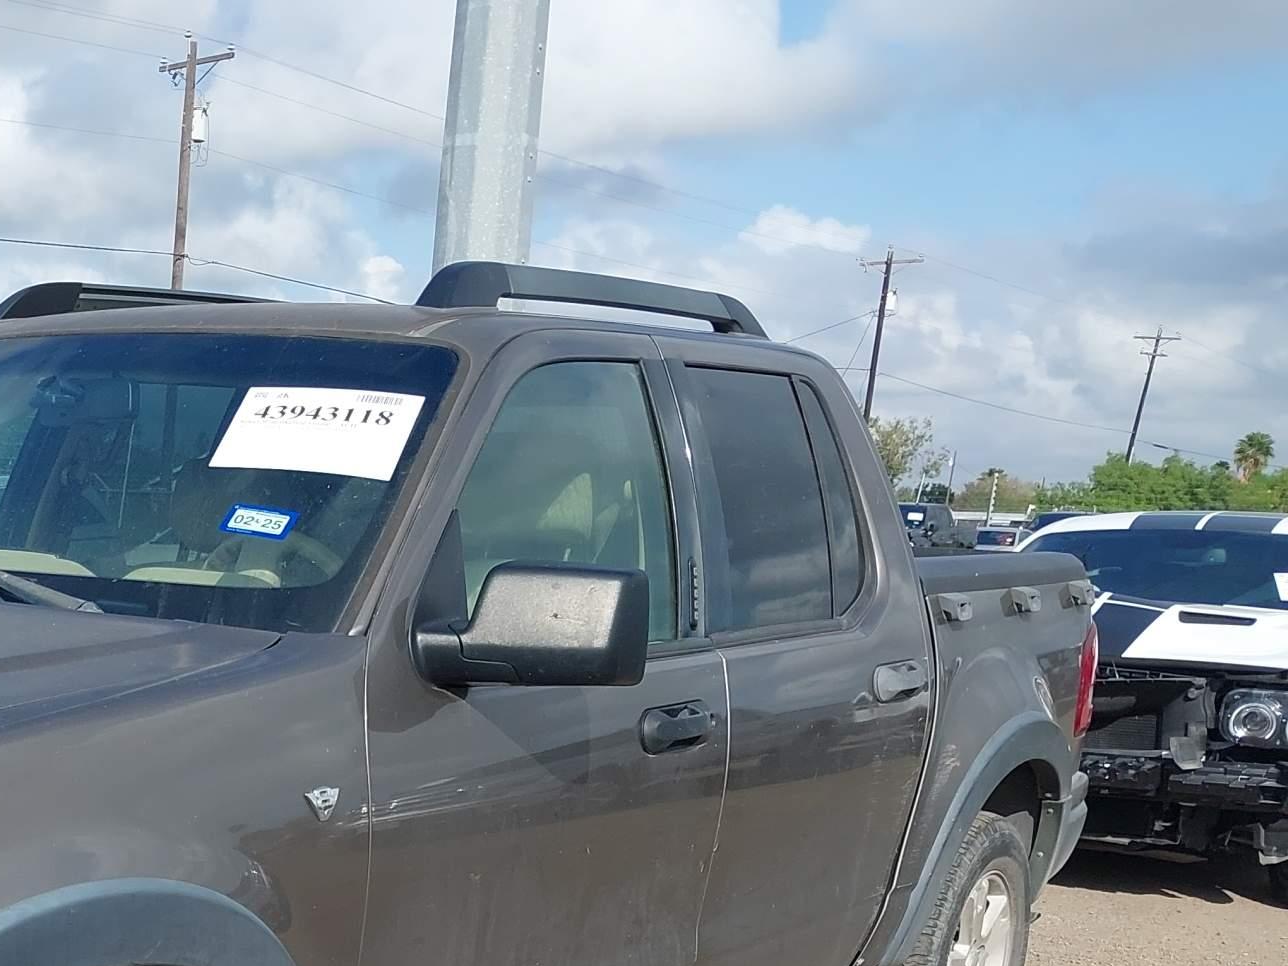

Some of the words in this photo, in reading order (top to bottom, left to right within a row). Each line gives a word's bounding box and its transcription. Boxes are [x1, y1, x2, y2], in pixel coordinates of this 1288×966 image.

[254, 404, 394, 427] 43943118
[233, 514, 255, 526] 02
[261, 518, 284, 530] 25
